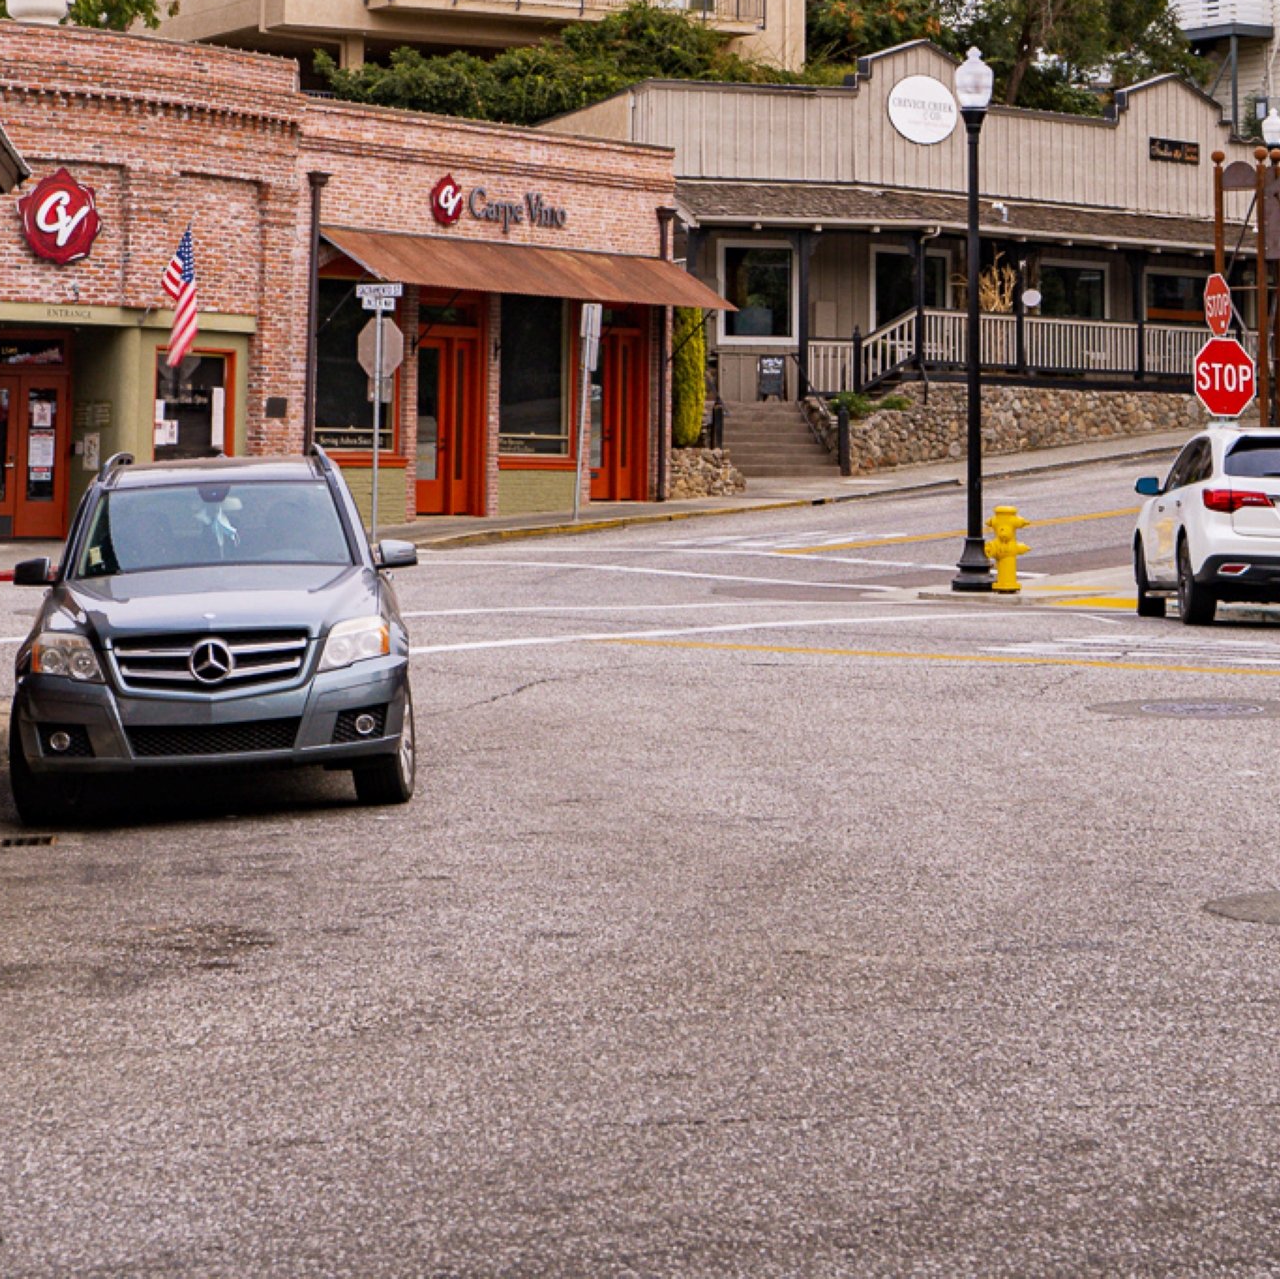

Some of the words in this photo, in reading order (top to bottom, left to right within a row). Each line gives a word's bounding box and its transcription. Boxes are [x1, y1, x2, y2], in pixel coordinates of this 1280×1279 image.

[469, 187, 524, 235] Carpe
[524, 192, 567, 229] Vino
[46, 307, 93, 319] ENTRANCE
[1206, 293, 1229, 318] STOP
[1197, 361, 1252, 393] STOP
